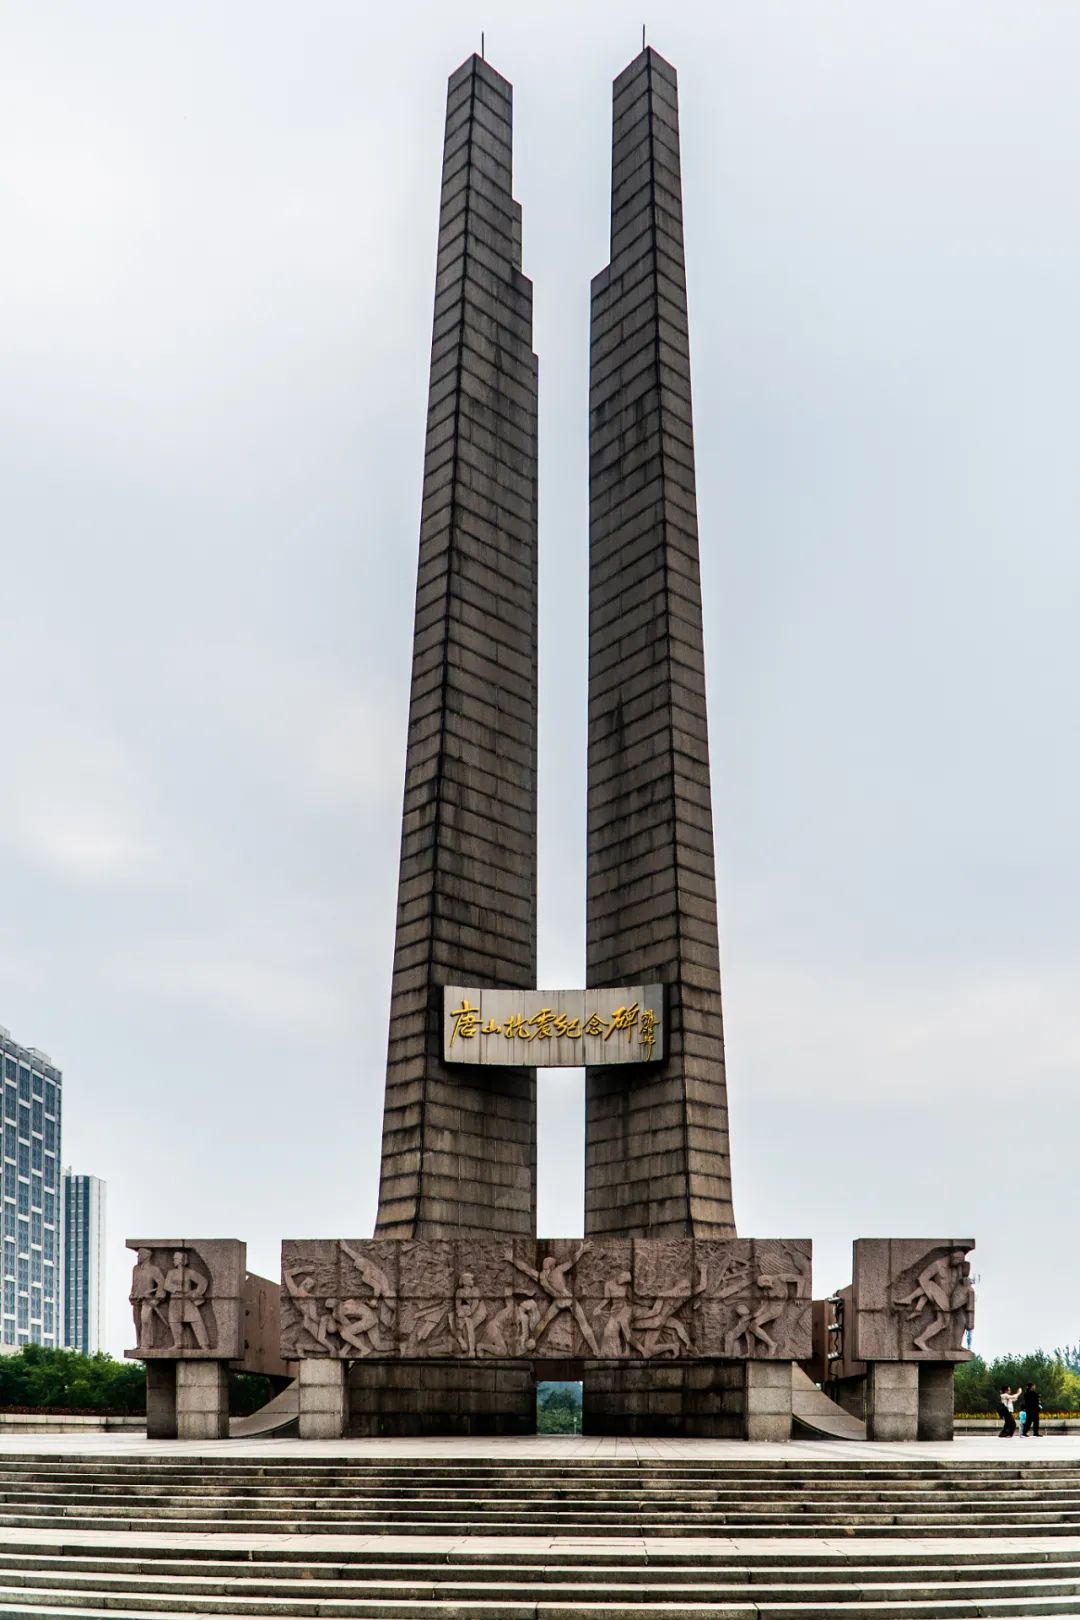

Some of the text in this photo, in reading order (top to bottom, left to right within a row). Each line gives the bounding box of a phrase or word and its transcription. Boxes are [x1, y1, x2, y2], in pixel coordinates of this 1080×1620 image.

[450, 999, 640, 1048] 唐山抗震纪念碑
